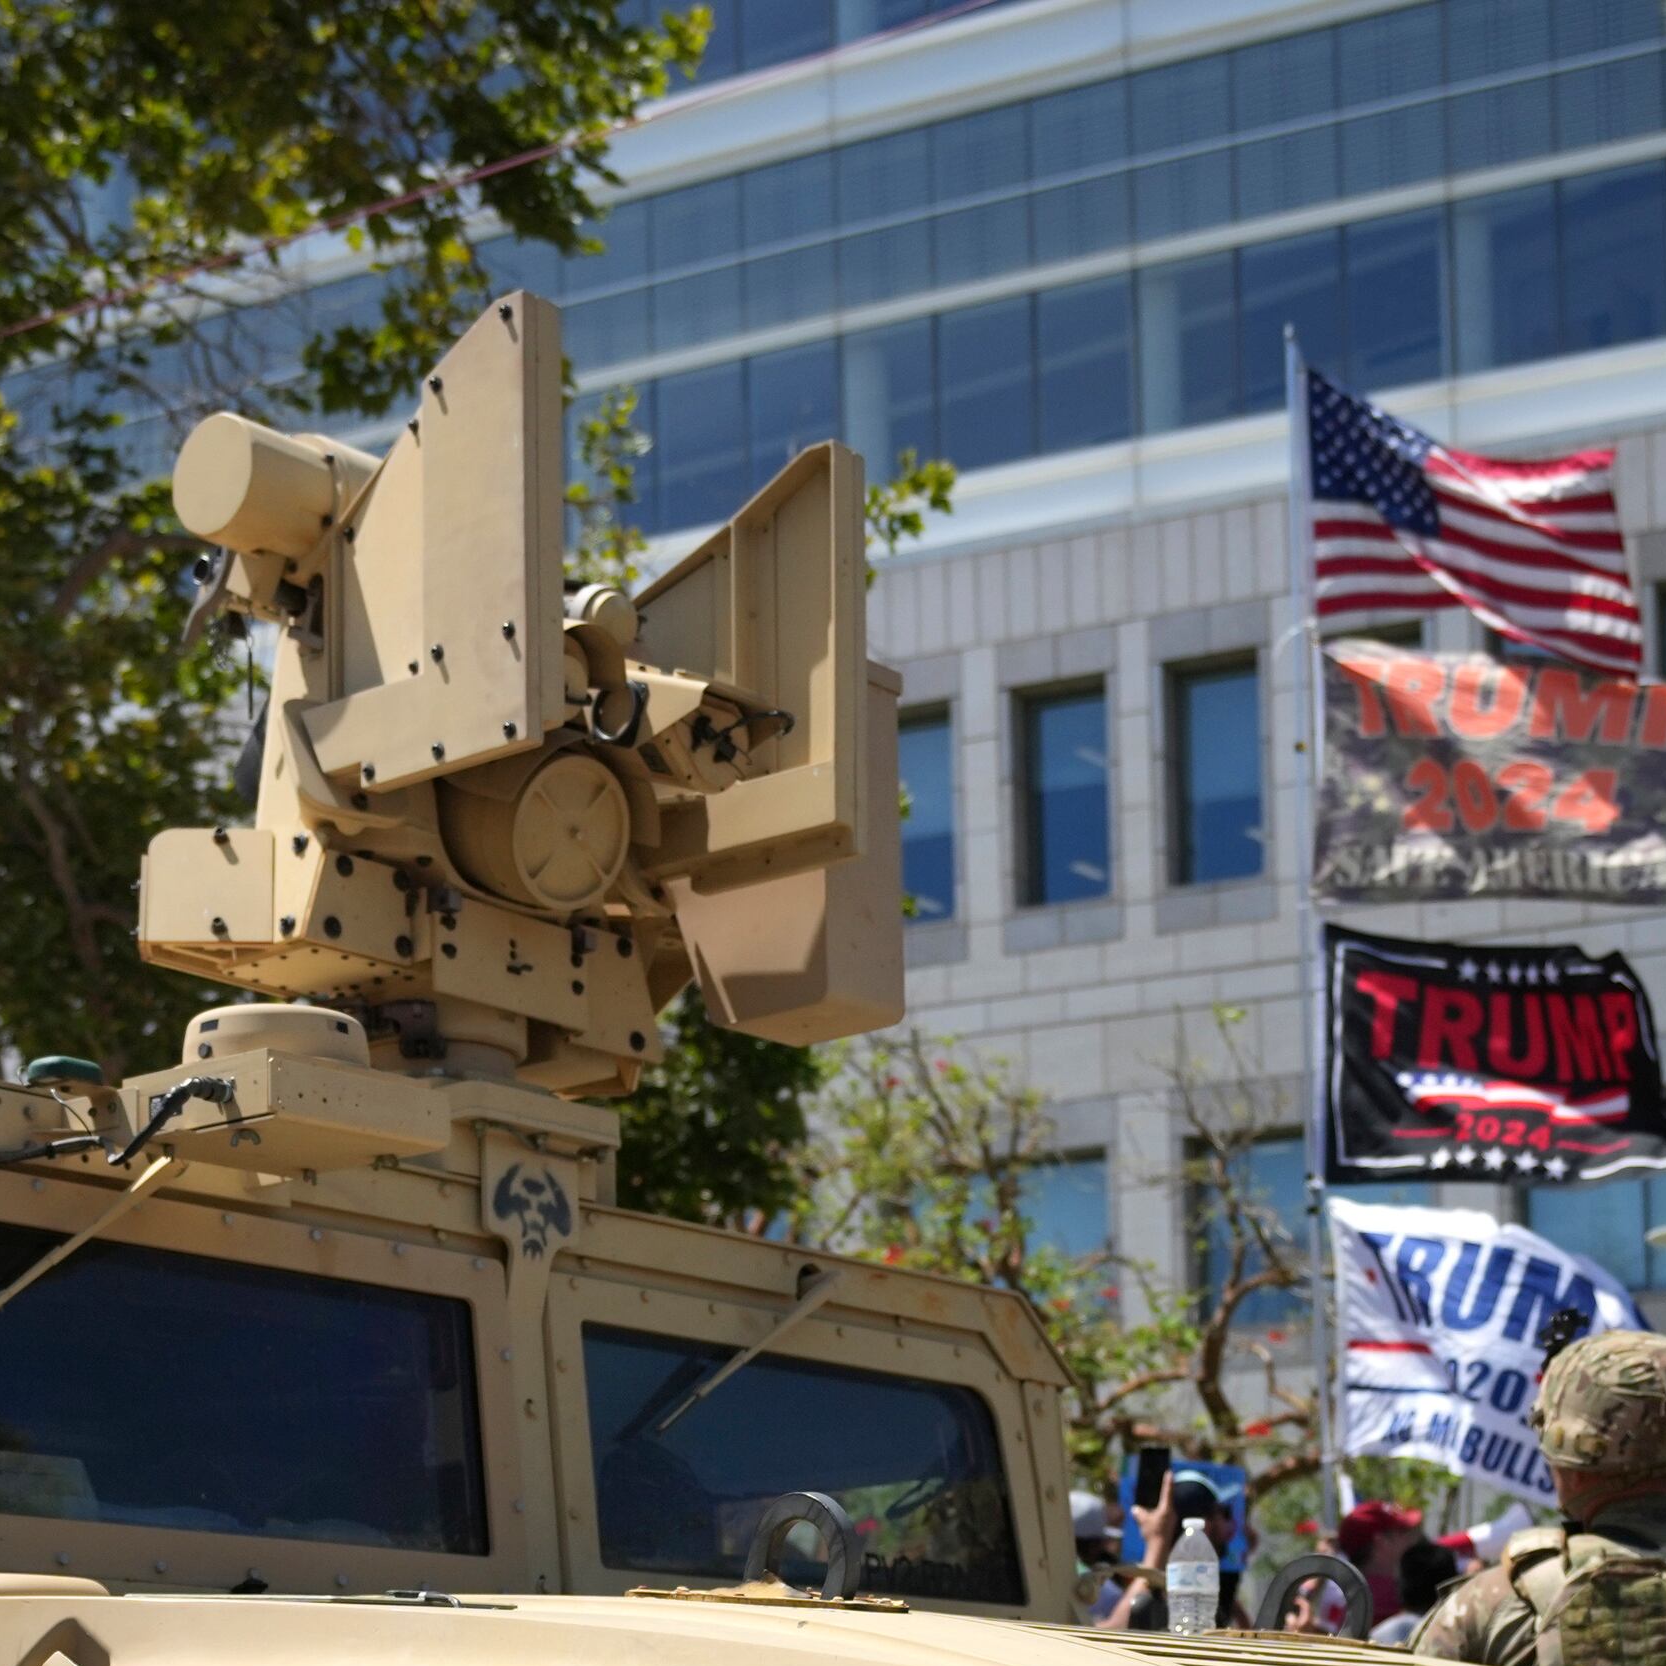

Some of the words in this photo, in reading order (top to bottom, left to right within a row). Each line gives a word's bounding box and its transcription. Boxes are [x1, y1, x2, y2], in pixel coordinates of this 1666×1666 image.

[1402, 759, 1621, 833] 2024
[1356, 971, 1639, 1083] TRUMP
[1455, 1113, 1553, 1151] 2024
[1359, 1231, 1599, 1349] TRUM
[1459, 1425, 1557, 1493] BULLS
